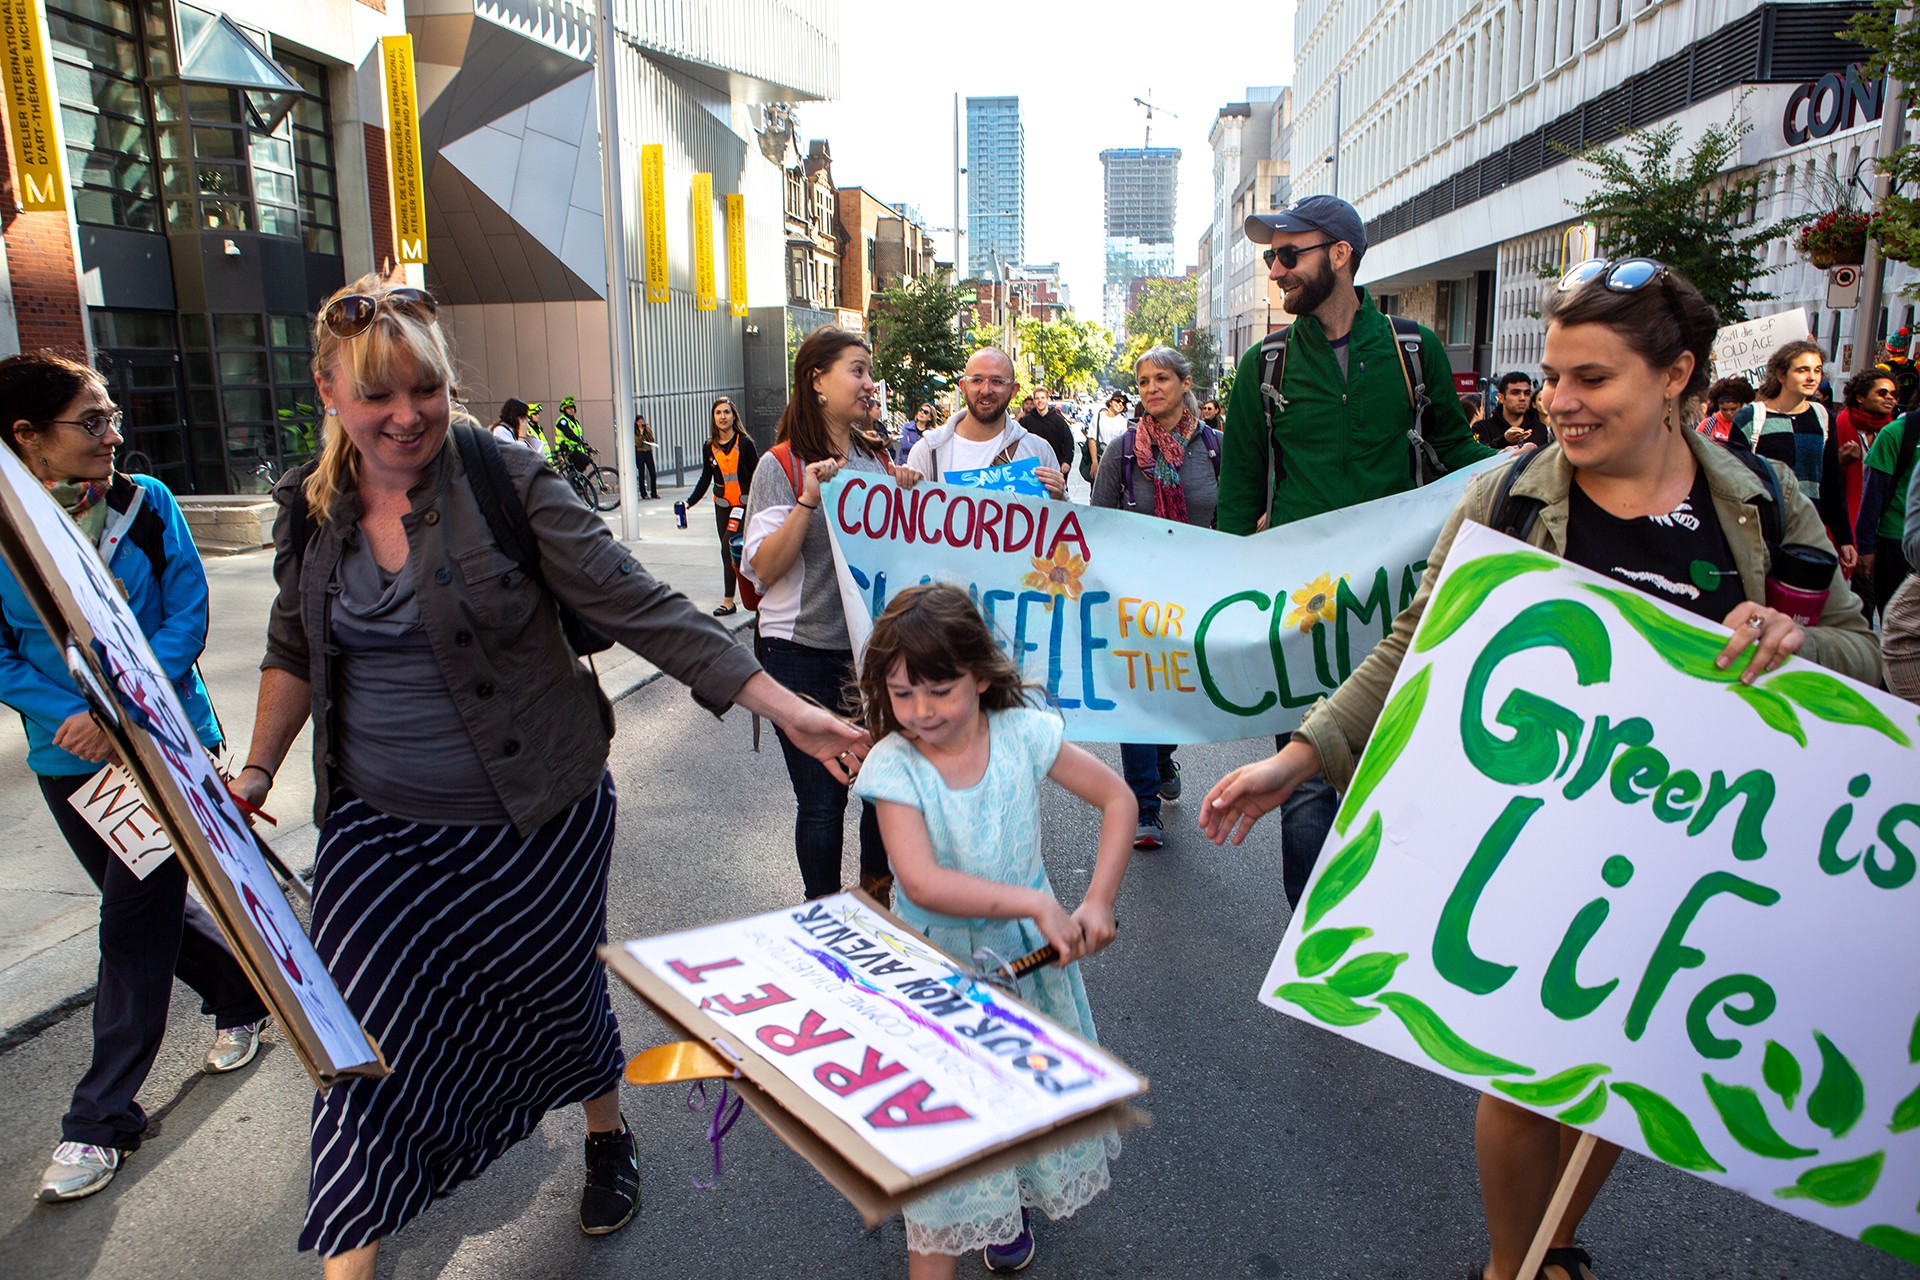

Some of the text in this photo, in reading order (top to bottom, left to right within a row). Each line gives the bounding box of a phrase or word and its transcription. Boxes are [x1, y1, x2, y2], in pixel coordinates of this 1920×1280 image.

[1, 0, 35, 165] ATELIER INTERNATIONAL
[15, 0, 49, 165] D'ART-THÉRAPIE MICHEL
[389, 47, 401, 117] INTERNATIONAL
[1782, 62, 1889, 147] CON
[399, 47, 418, 234] ATELIER FOR EDUCATION AND ART THERAPY
[24, 172, 56, 203] M
[398, 175, 405, 186] LA
[400, 187, 407, 200] DE
[400, 202, 409, 234] MICHEL
[401, 238, 423, 259] M
[651, 285, 666, 299] M
[1716, 318, 1776, 345] You'll die of
[1721, 353, 1765, 372] I'll die
[1722, 335, 1774, 359] OLD AGE
[961, 465, 1016, 488] SAVE
[837, 477, 1092, 562] CONCORDIA
[1117, 597, 1186, 639] FOR
[1112, 649, 1196, 692] THE
[1460, 598, 1777, 861] Green
[83, 767, 172, 865] WE?
[1818, 773, 1920, 890] is
[790, 902, 917, 976] AVENIR
[1431, 794, 1782, 1060] Life
[664, 957, 978, 1129] ARRÊT
[953, 1016, 1097, 1095] POUR
